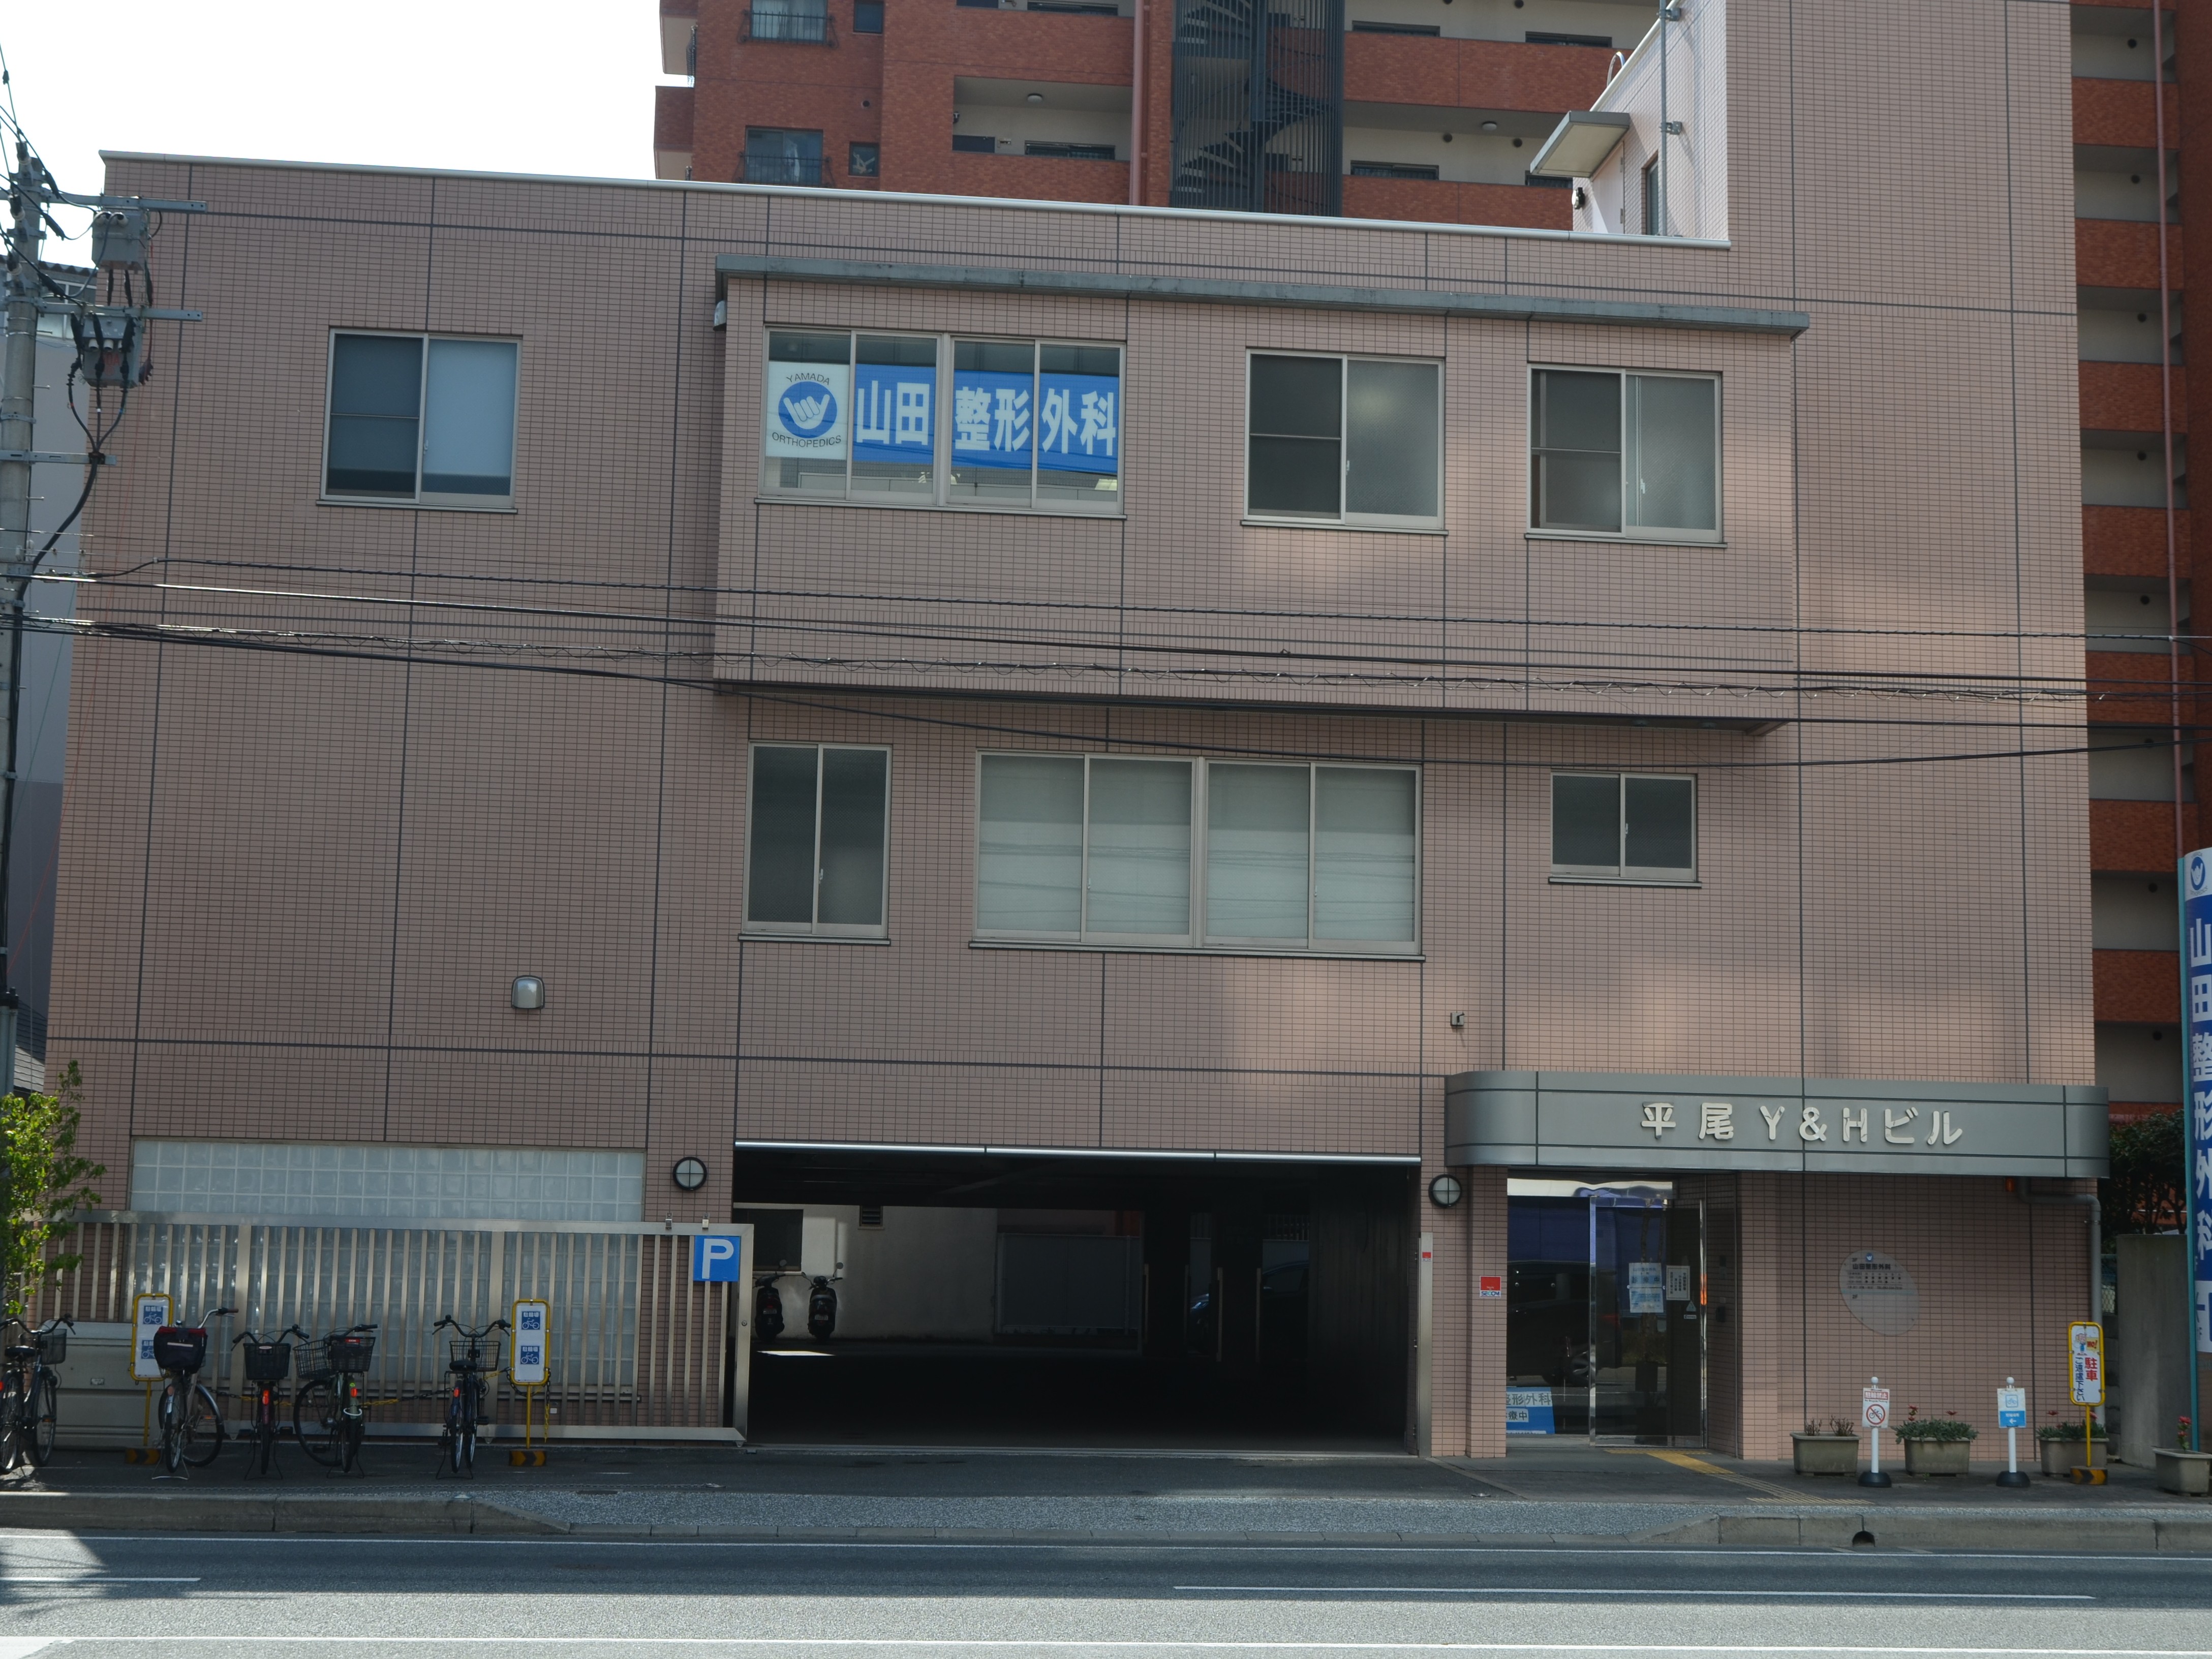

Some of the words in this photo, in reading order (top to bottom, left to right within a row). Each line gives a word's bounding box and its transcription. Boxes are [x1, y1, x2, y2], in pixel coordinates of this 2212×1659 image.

[786, 373, 830, 385] YAMADA
[856, 380, 1116, 456] 山田整形外科
[772, 432, 841, 448] ORTHOPEDICS
[702, 1238, 734, 1279] P
[2085, 1357, 2098, 1381] 駐車
[1506, 1411, 1527, 1420] 療中
